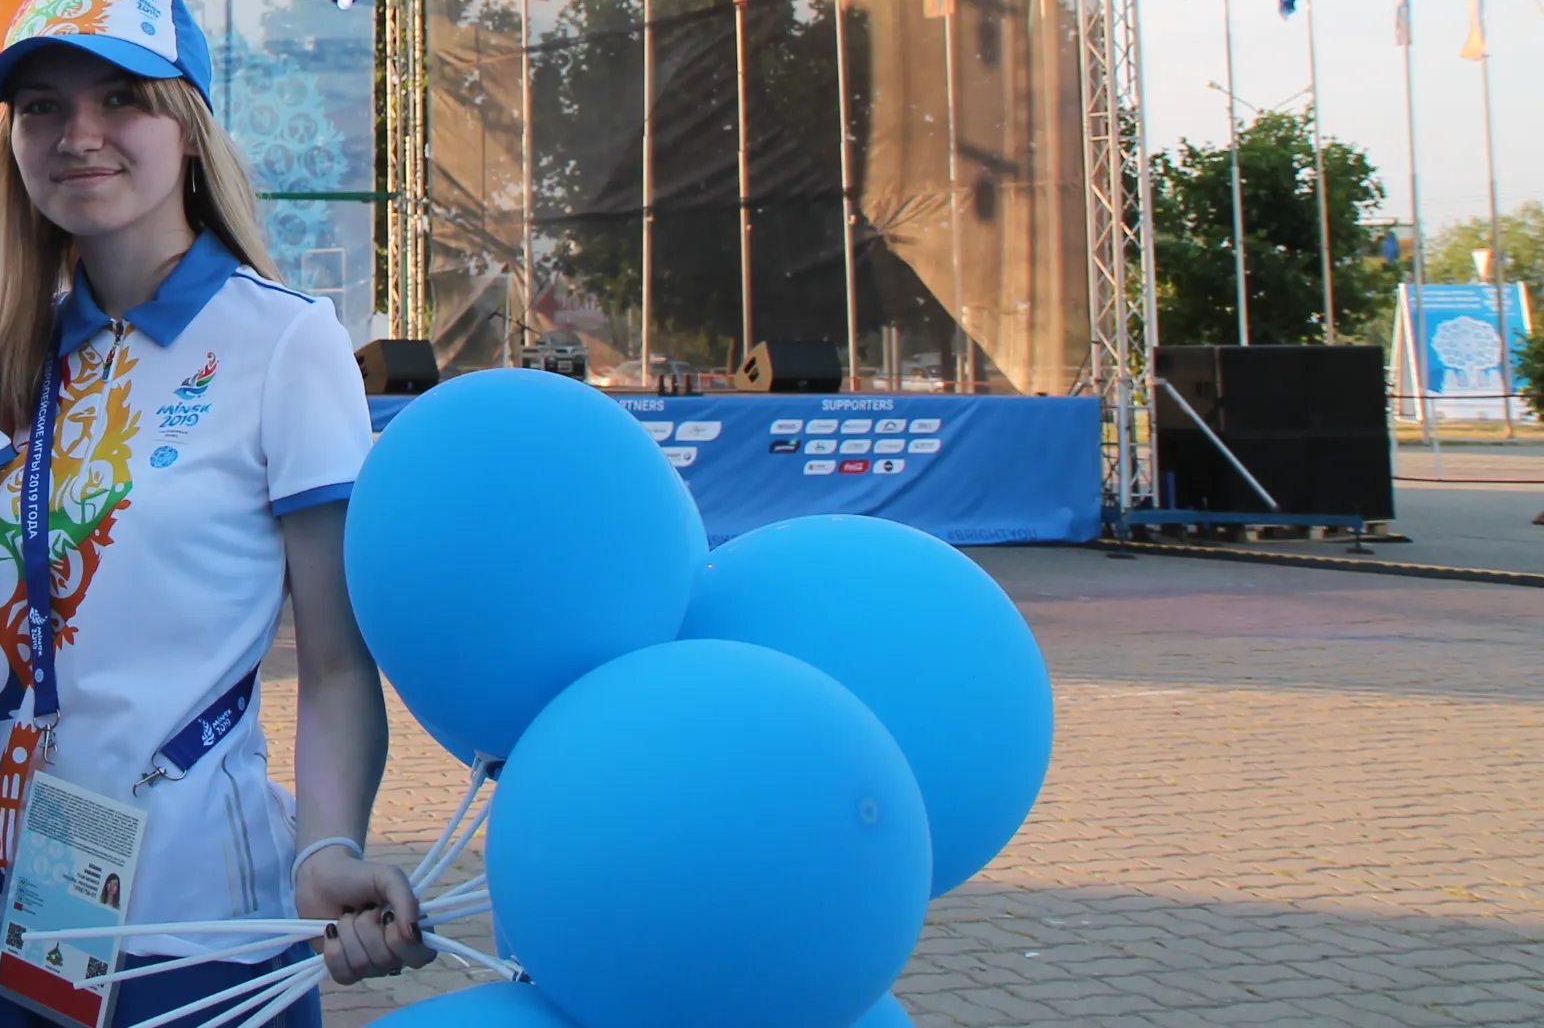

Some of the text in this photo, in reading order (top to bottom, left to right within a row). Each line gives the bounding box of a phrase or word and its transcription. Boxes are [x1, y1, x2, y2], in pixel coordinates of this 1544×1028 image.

[619, 400, 665, 411] RTNERS
[822, 399, 894, 411] SUPPORTERS
[159, 413, 199, 428] 2019
[31, 439, 44, 472] ИГРЫ
[28, 472, 40, 503] 2019
[27, 503, 38, 540] ГОДА
